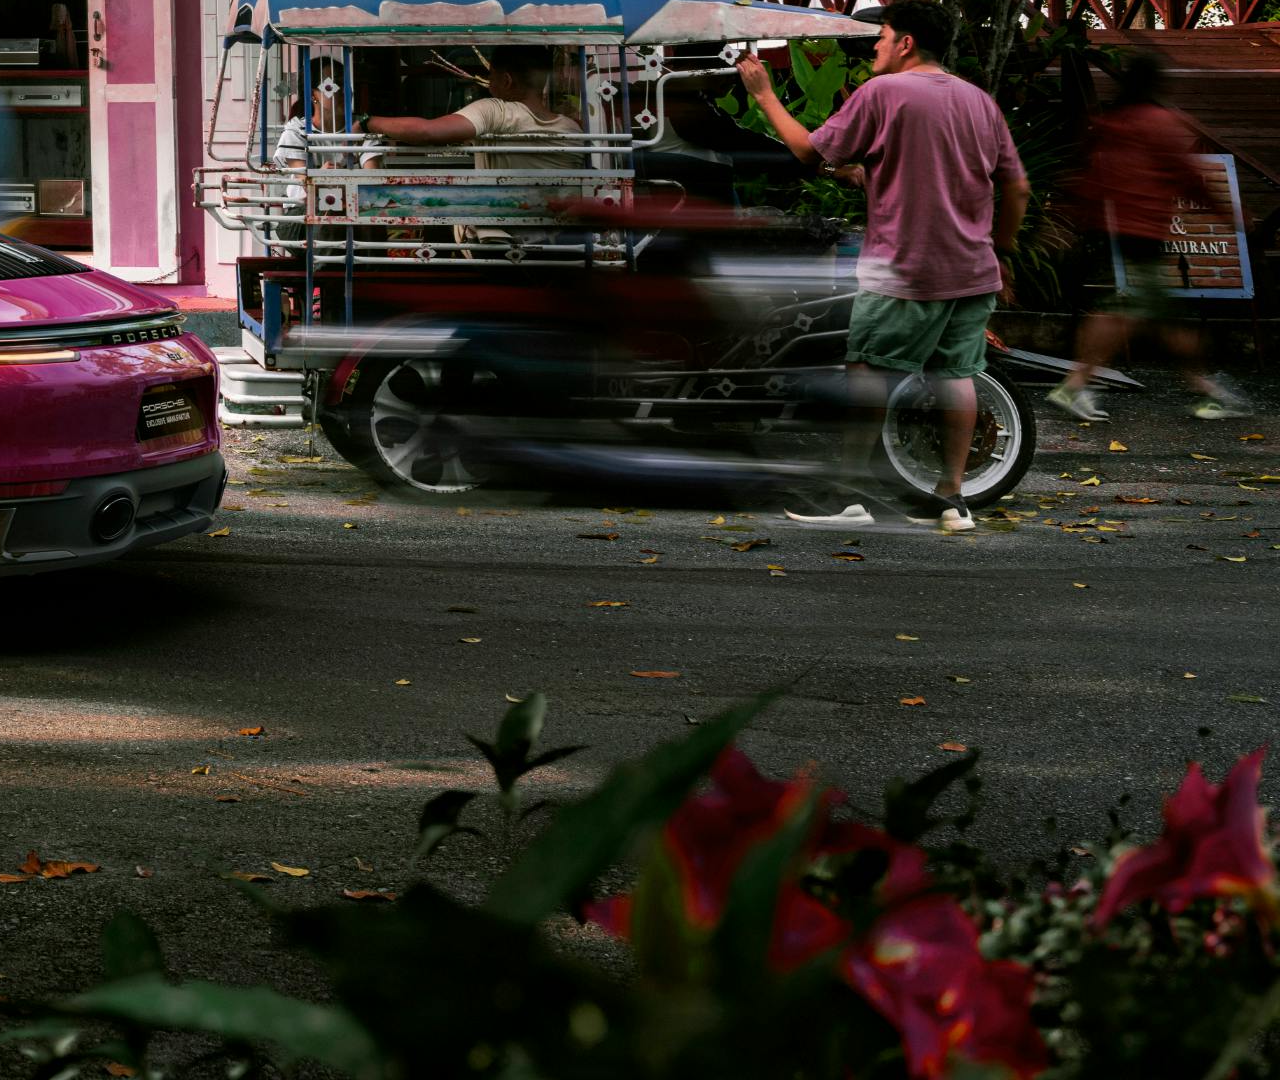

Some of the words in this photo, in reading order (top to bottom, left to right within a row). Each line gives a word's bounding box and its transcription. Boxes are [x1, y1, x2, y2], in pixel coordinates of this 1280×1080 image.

[1169, 215, 1187, 235] &
[1161, 240, 1229, 254] TAURANT
[142, 398, 185, 414] PORSCHE
[145, 417, 167, 428] EXCLUSIVE
